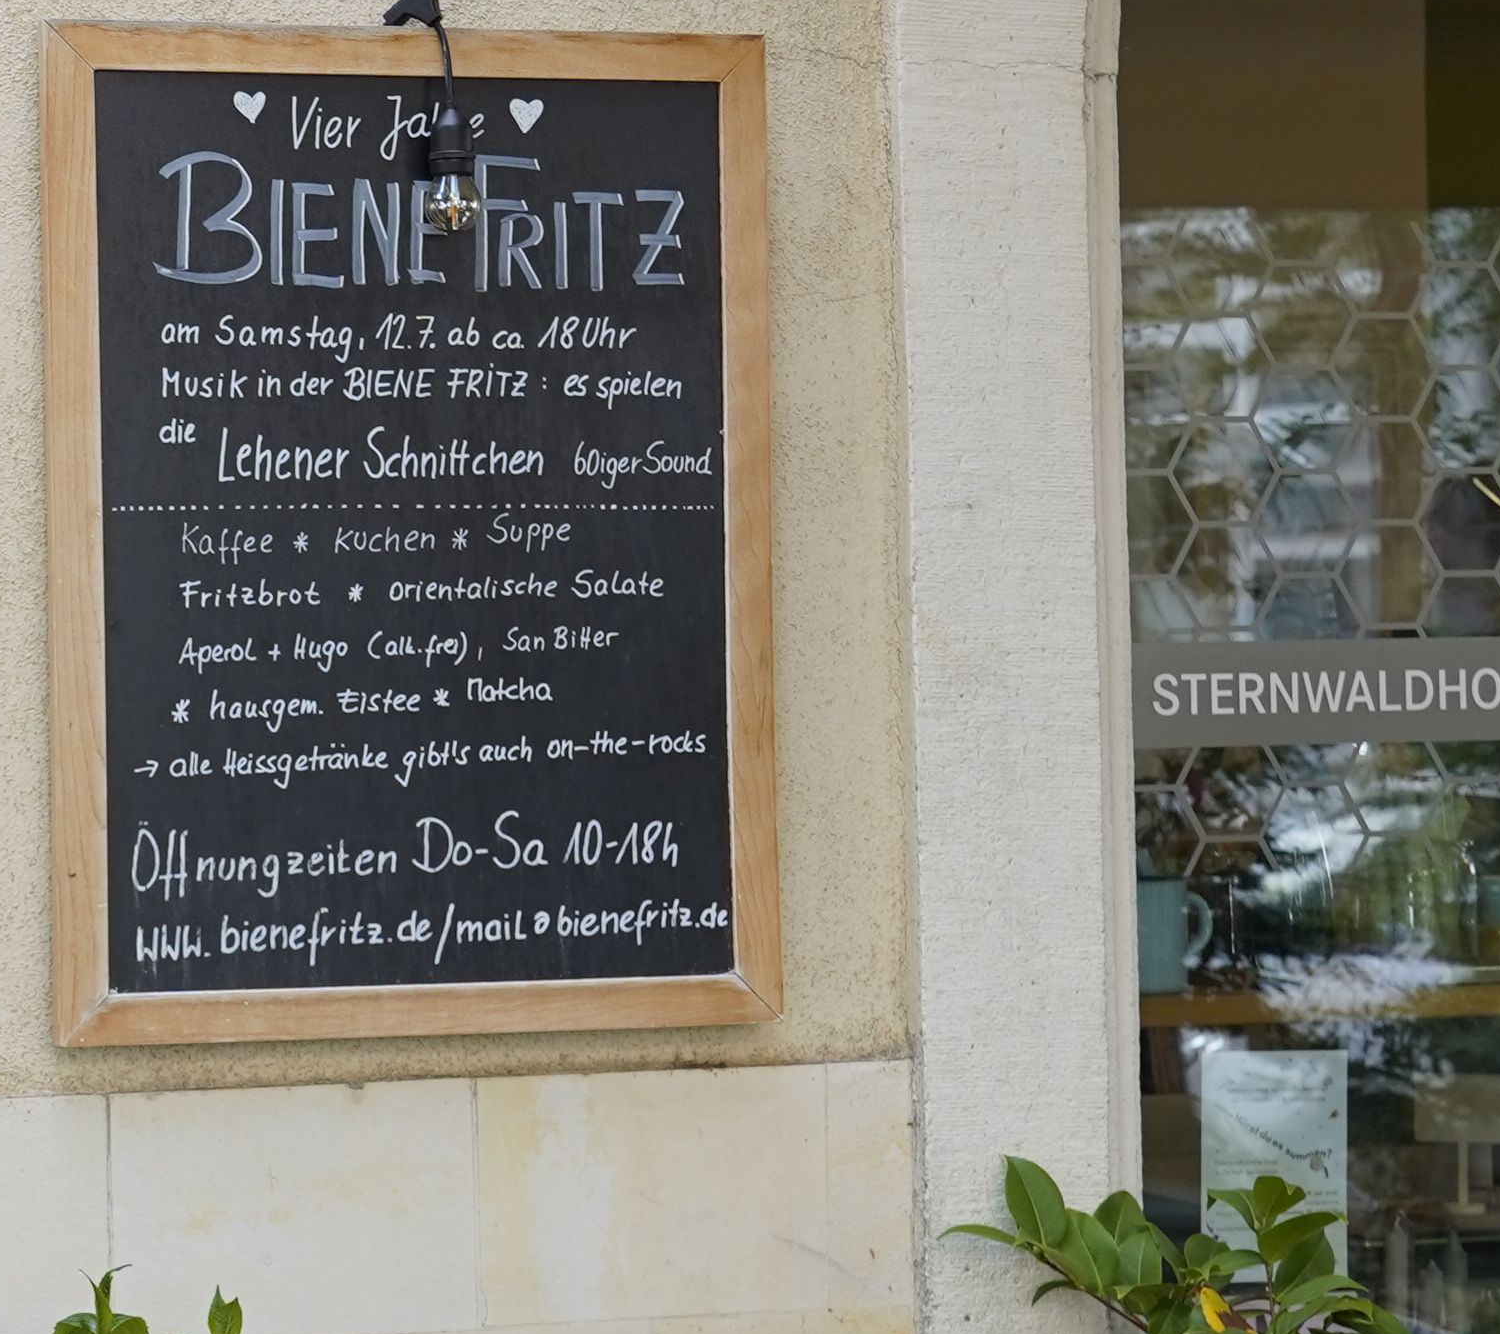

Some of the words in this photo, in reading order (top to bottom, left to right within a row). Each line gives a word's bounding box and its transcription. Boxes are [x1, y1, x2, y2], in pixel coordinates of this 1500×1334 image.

[292, 96, 361, 149] Vier
[380, 95, 485, 161] Jae
[161, 323, 199, 344] am
[215, 317, 364, 363] Samstag,
[376, 313, 435, 350] 12.7.
[448, 317, 480, 346] ab
[492, 330, 524, 349] ca.
[162, 367, 245, 398] Musik
[258, 369, 281, 397] in
[290, 371, 333, 396] der
[343, 367, 434, 401] BIENE
[564, 374, 589, 396] es
[597, 372, 681, 410] spielen
[159, 418, 196, 444] die
[219, 427, 349, 482] Lehener
[363, 426, 543, 479] Schnittchen
[182, 522, 273, 564] Kaffee
[335, 527, 435, 553] Kuchen
[487, 513, 571, 552] Suppe
[179, 579, 320, 608] Fritzbrot
[389, 574, 557, 602] orientalische
[571, 569, 663, 598] Salate
[179, 639, 257, 674] Aperol
[294, 634, 348, 669] Hugo
[503, 627, 545, 652] San
[554, 626, 619, 650] Bitter
[210, 689, 323, 733] hausgem.
[337, 689, 420, 714] Eistee
[170, 751, 212, 777] alle
[223, 743, 388, 789] Heissgetränke
[479, 736, 532, 762] auch
[547, 731, 706, 759] on-the-rocks
[412, 810, 548, 873] Do-Sa
[563, 819, 678, 867] 10-18h
